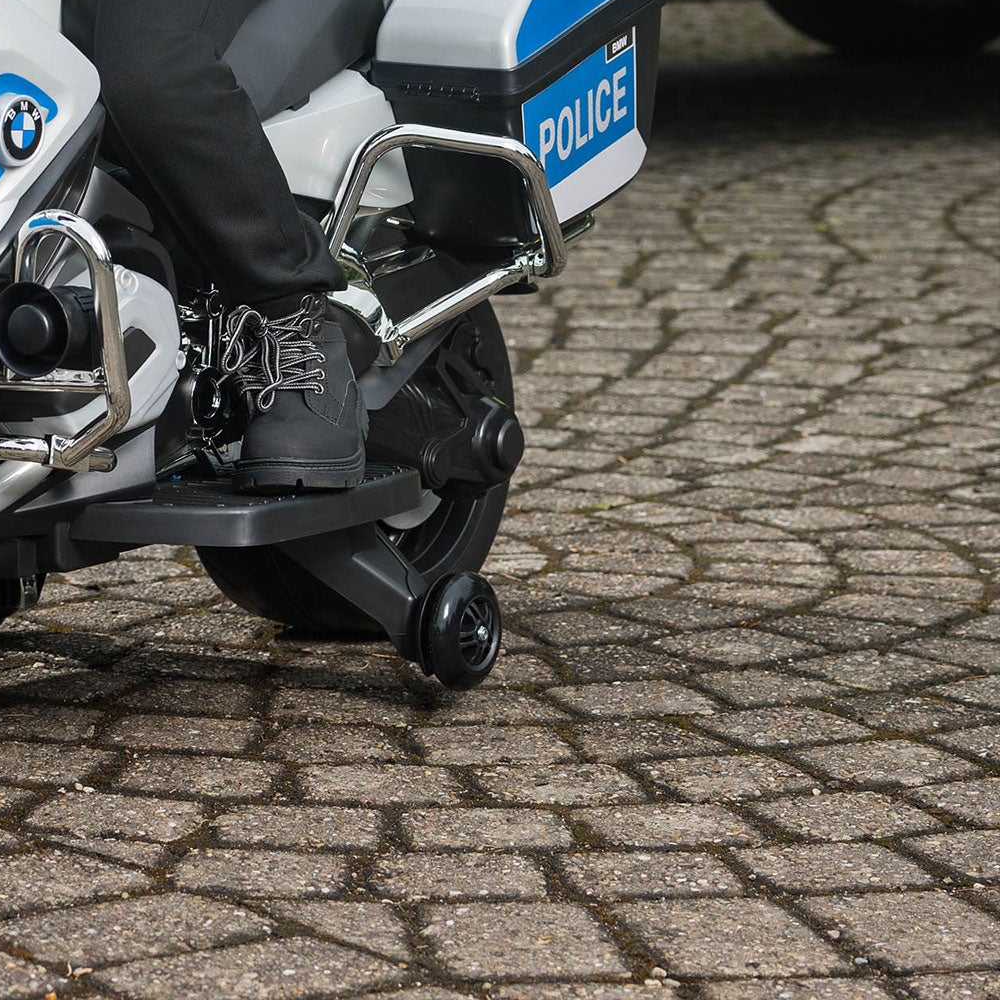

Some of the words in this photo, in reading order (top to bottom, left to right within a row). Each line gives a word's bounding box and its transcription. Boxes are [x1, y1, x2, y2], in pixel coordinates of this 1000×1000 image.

[613, 34, 628, 54] BMW
[4, 101, 41, 123] BMW
[539, 66, 627, 167] POLICE
